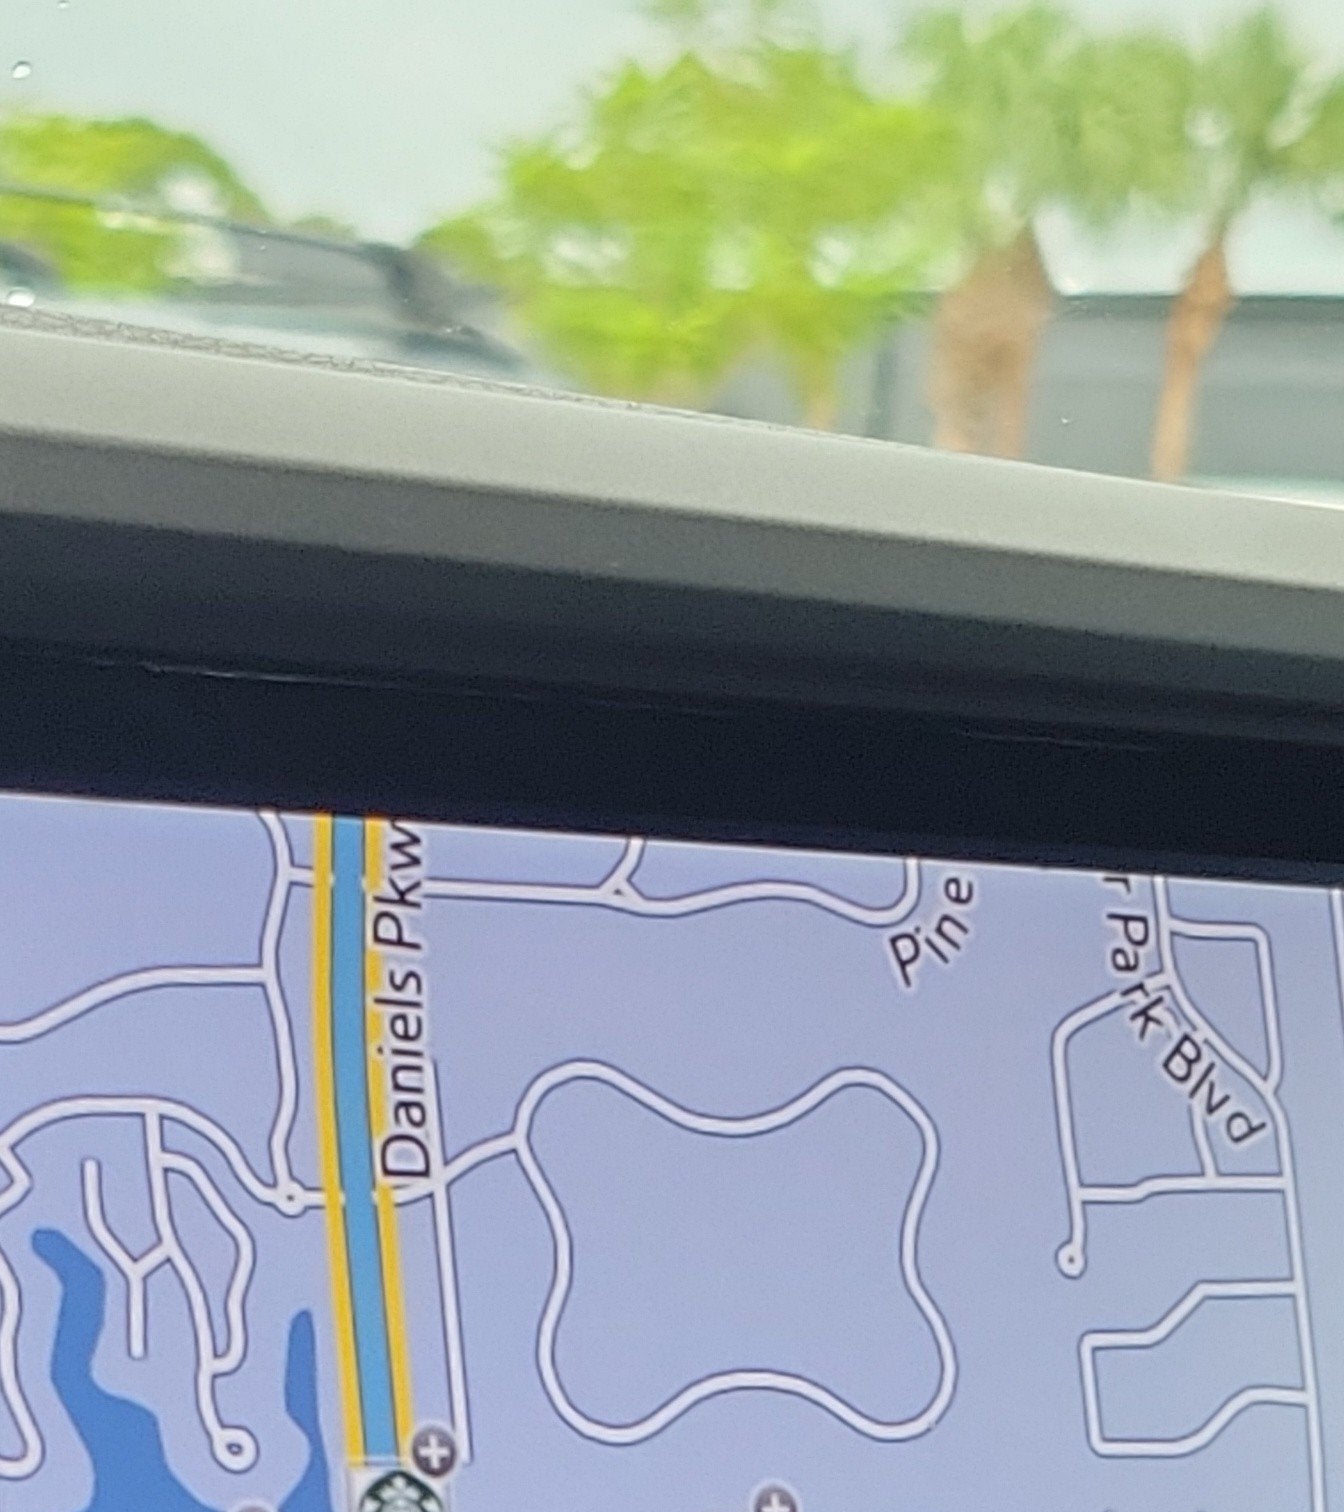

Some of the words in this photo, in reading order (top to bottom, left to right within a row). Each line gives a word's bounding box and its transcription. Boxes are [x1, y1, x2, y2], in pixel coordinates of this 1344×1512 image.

[888, 875, 974, 988] Pine
[1106, 912, 1165, 1042] Park
[1162, 1033, 1267, 1146] Blvd
[373, 967, 431, 1179] Daniels
